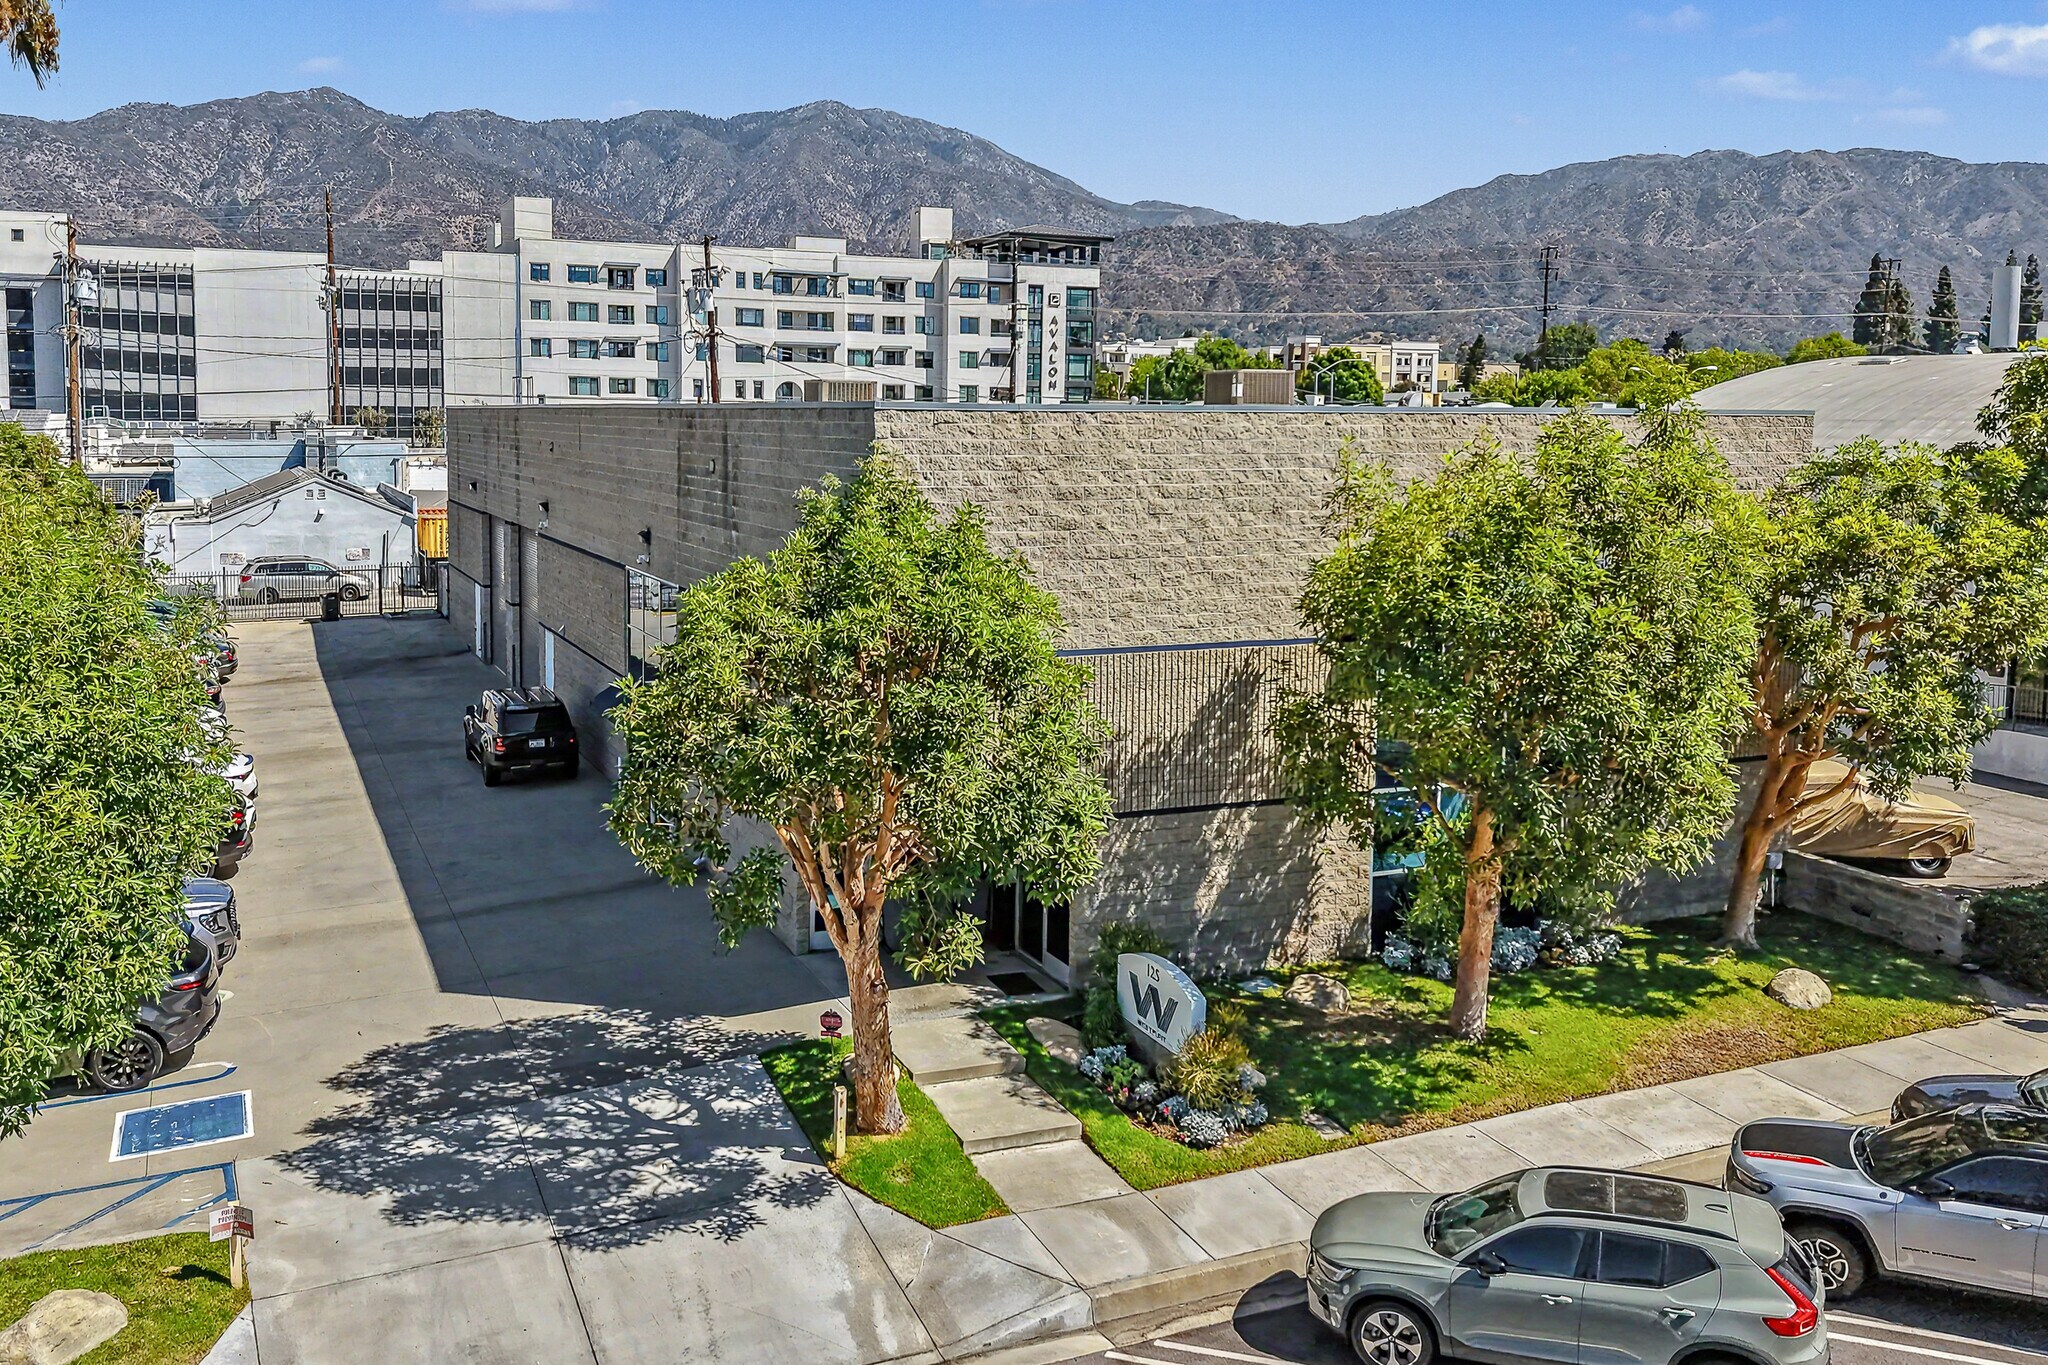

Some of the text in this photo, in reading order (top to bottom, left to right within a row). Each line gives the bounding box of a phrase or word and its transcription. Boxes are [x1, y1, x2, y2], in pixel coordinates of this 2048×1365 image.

[1048, 315, 1059, 391] AVALON
[1128, 970, 1179, 1034] W
[1147, 963, 1160, 983] 125
